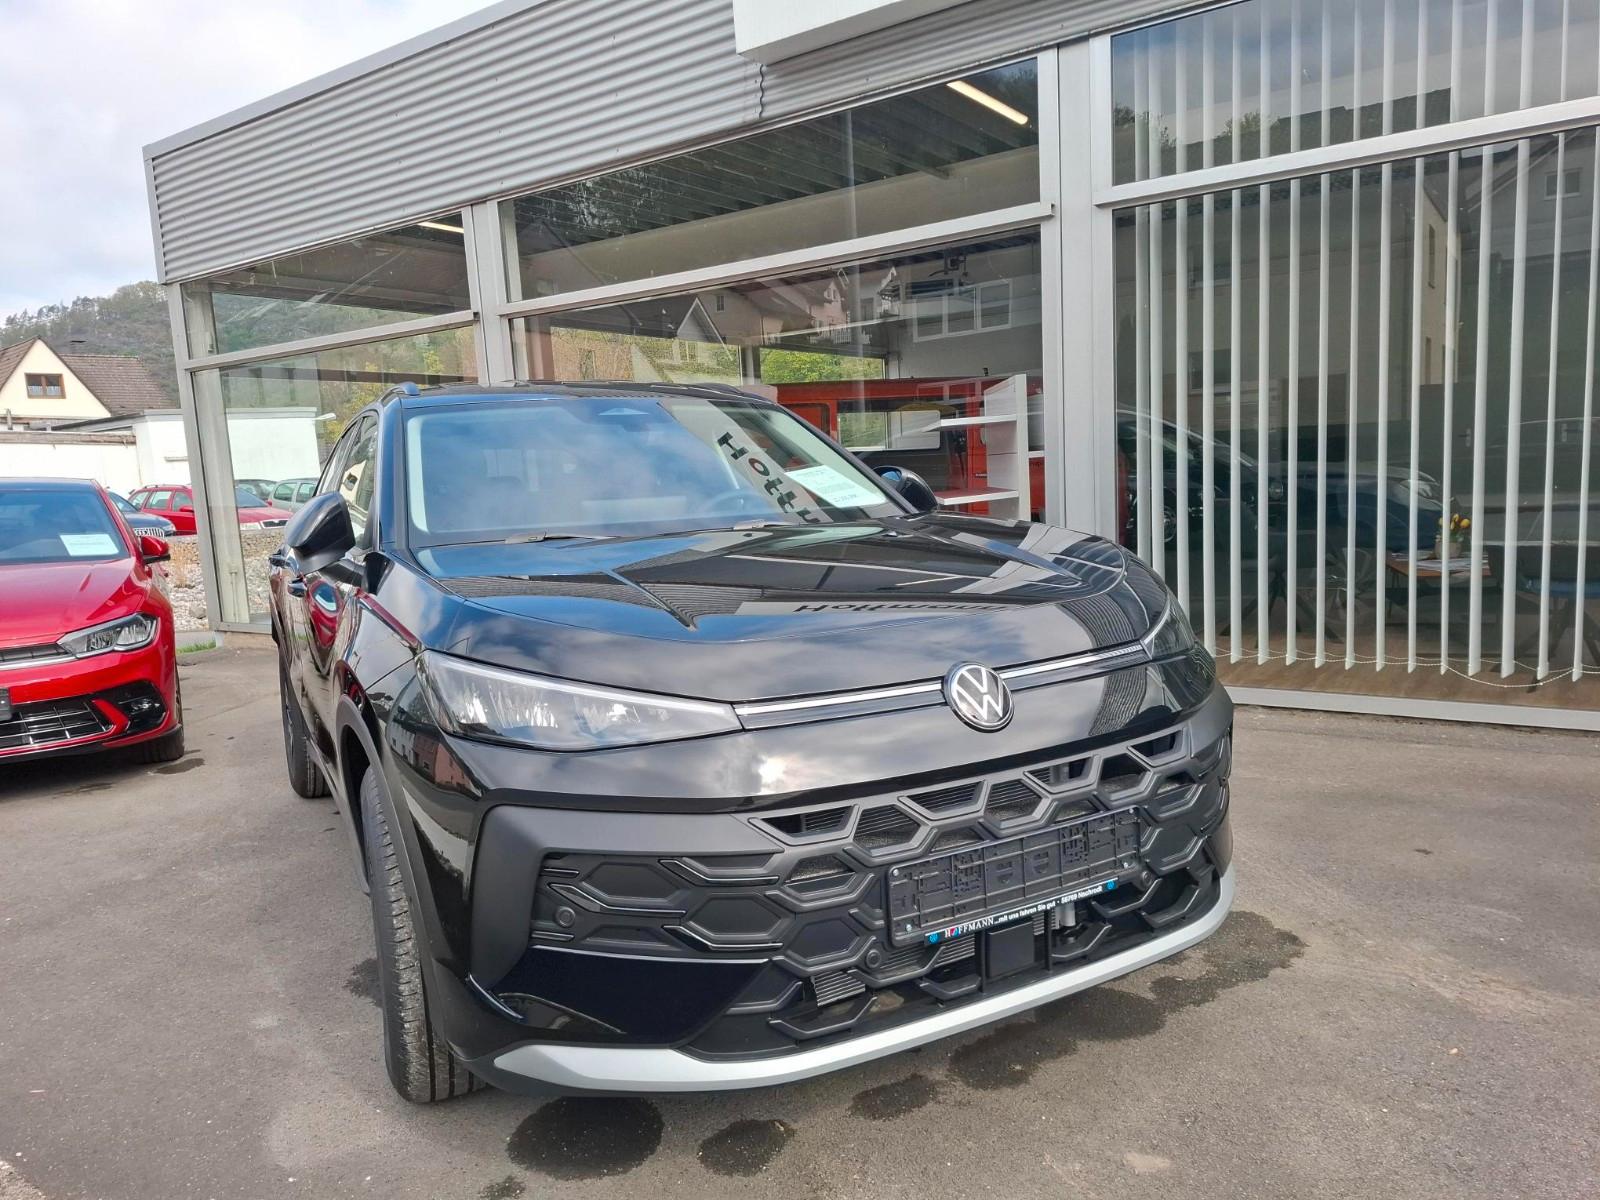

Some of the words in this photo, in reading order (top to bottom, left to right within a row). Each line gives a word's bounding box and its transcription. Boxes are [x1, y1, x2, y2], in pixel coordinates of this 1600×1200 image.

[944, 917, 994, 938] HOFFMANN
[1037, 904, 1046, 912] Sie
[1046, 901, 1056, 909] gut
